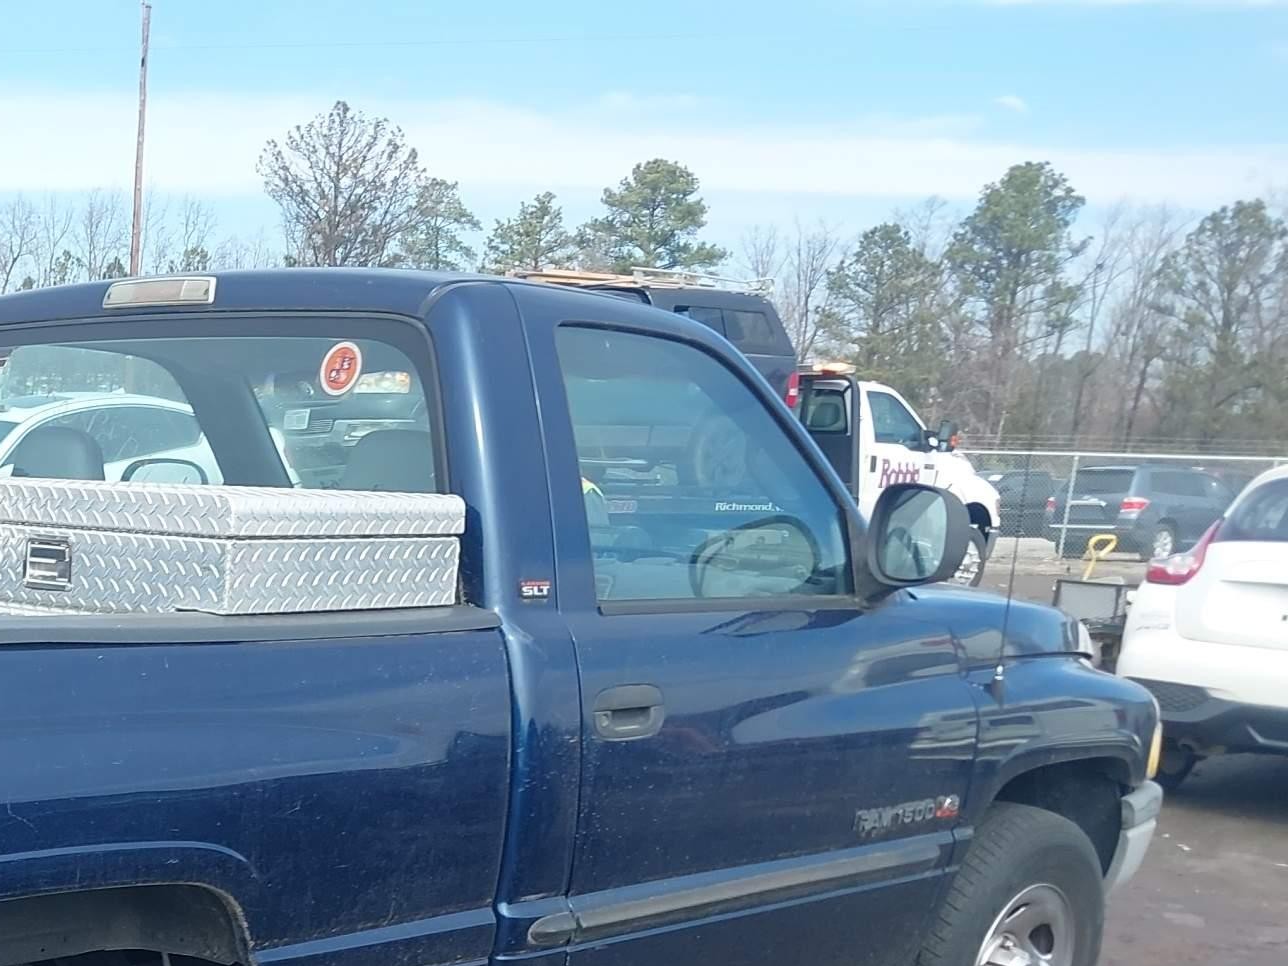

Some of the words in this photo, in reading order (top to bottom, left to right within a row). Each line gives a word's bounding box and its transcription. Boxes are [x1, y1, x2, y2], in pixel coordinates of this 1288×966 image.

[522, 585, 551, 596] SLT
[854, 806, 893, 835] RAM
[895, 799, 936, 825] 1500
